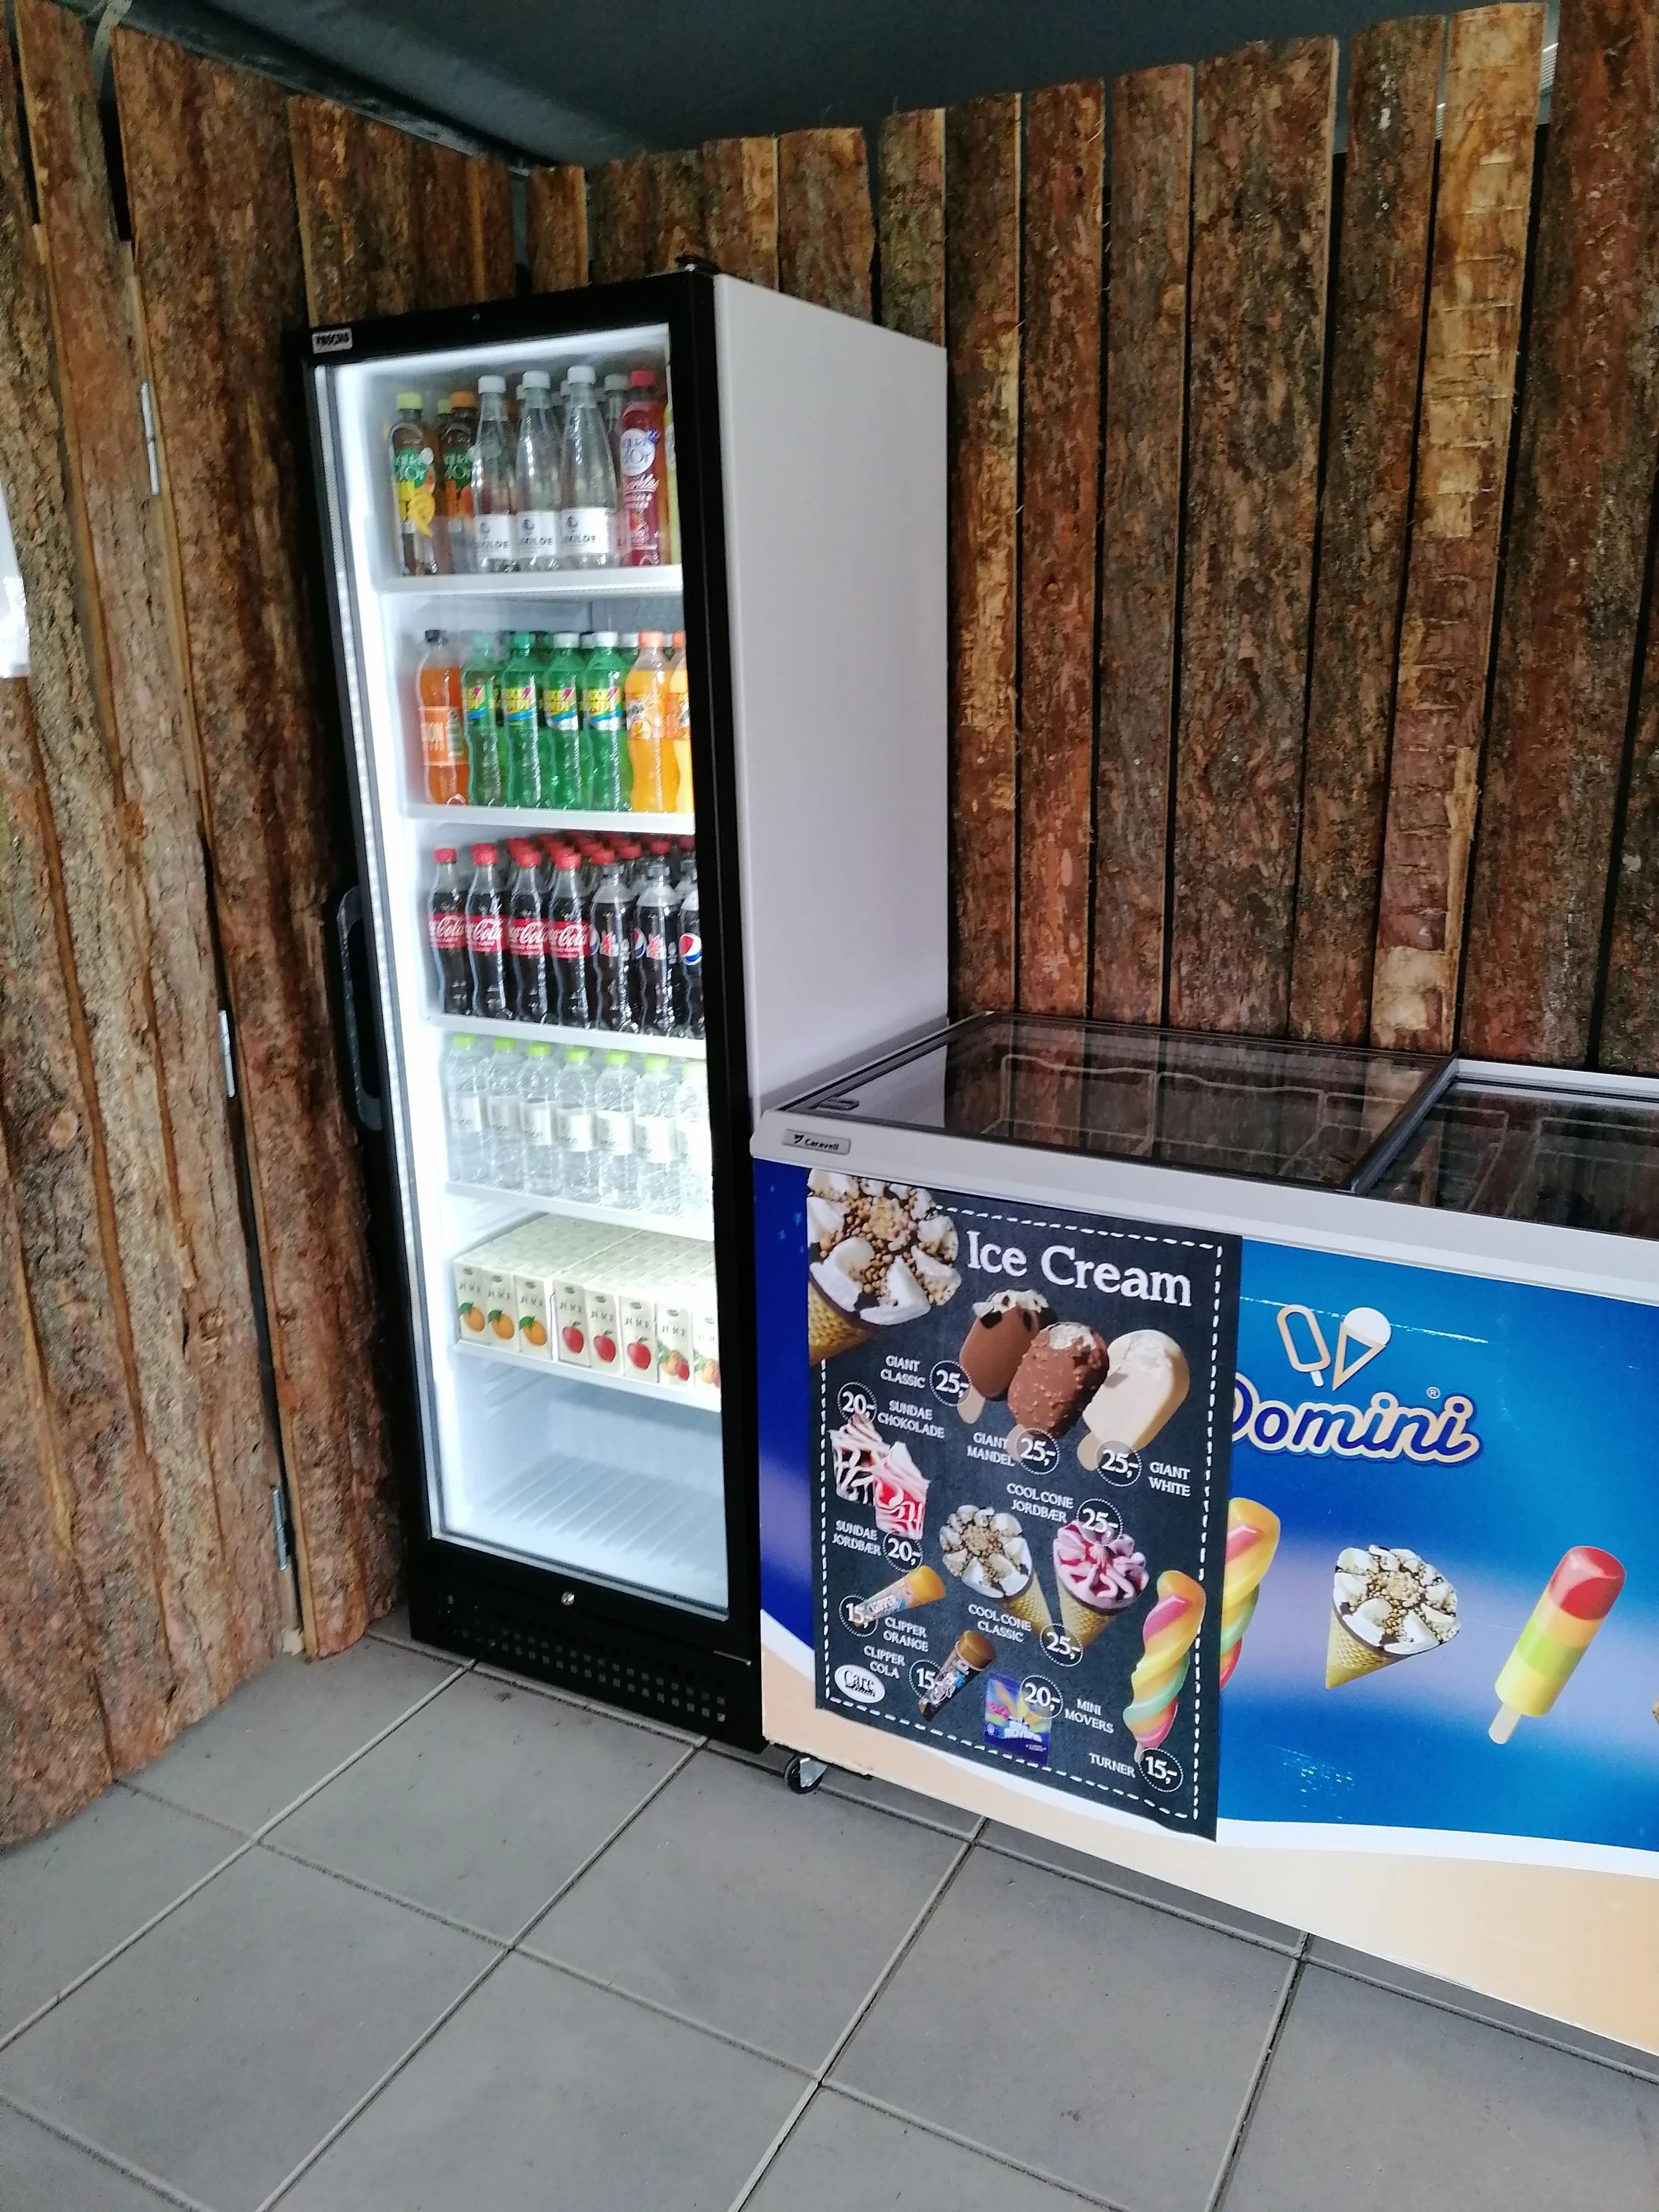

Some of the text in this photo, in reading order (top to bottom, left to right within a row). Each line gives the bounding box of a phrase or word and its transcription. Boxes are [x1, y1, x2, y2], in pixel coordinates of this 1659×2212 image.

[805, 1139, 839, 1151] Caravell
[966, 1230, 1192, 1307] Ice Cream
[885, 1355, 921, 1372] GIANT
[880, 1368, 926, 1389] CLASSIC
[936, 1369, 970, 1398] 25,-
[842, 1390, 875, 1419] 20,-
[889, 1400, 934, 1421] SUNDAE
[877, 1412, 946, 1439] CHOKOLADE
[972, 1431, 1009, 1449] GIANT
[1020, 1438, 1056, 1467] 25,-
[966, 1445, 1015, 1467] MANDEL
[1101, 1449, 1139, 1479] 25,-
[1149, 1461, 1191, 1481] GIANT
[1006, 1483, 1074, 1509] COOL CONE
[1148, 1476, 1191, 1497] WHITE
[1011, 1499, 1068, 1524] JORDBÆR
[1082, 1508, 1119, 1538] 25,-
[835, 1519, 879, 1541] SUNDAE
[832, 1532, 883, 1557] JORDBÆR
[887, 1538, 921, 1566] 20,-
[885, 1616, 928, 1639] CLIPPER
[968, 1603, 1033, 1632] COOL CONE
[883, 1630, 929, 1653] ORANGE
[977, 1620, 1025, 1643] CLASSIC
[864, 1645, 906, 1666] CLIPPER
[1046, 1631, 1081, 1660] 25,-
[870, 1660, 900, 1679] COLA
[1024, 1682, 1061, 1712] 20,-
[1076, 1698, 1102, 1716] MINI
[1064, 1708, 1115, 1735] MOVERS
[1088, 1752, 1137, 1779] TURNER
[1145, 1756, 1179, 1785] 15,-
